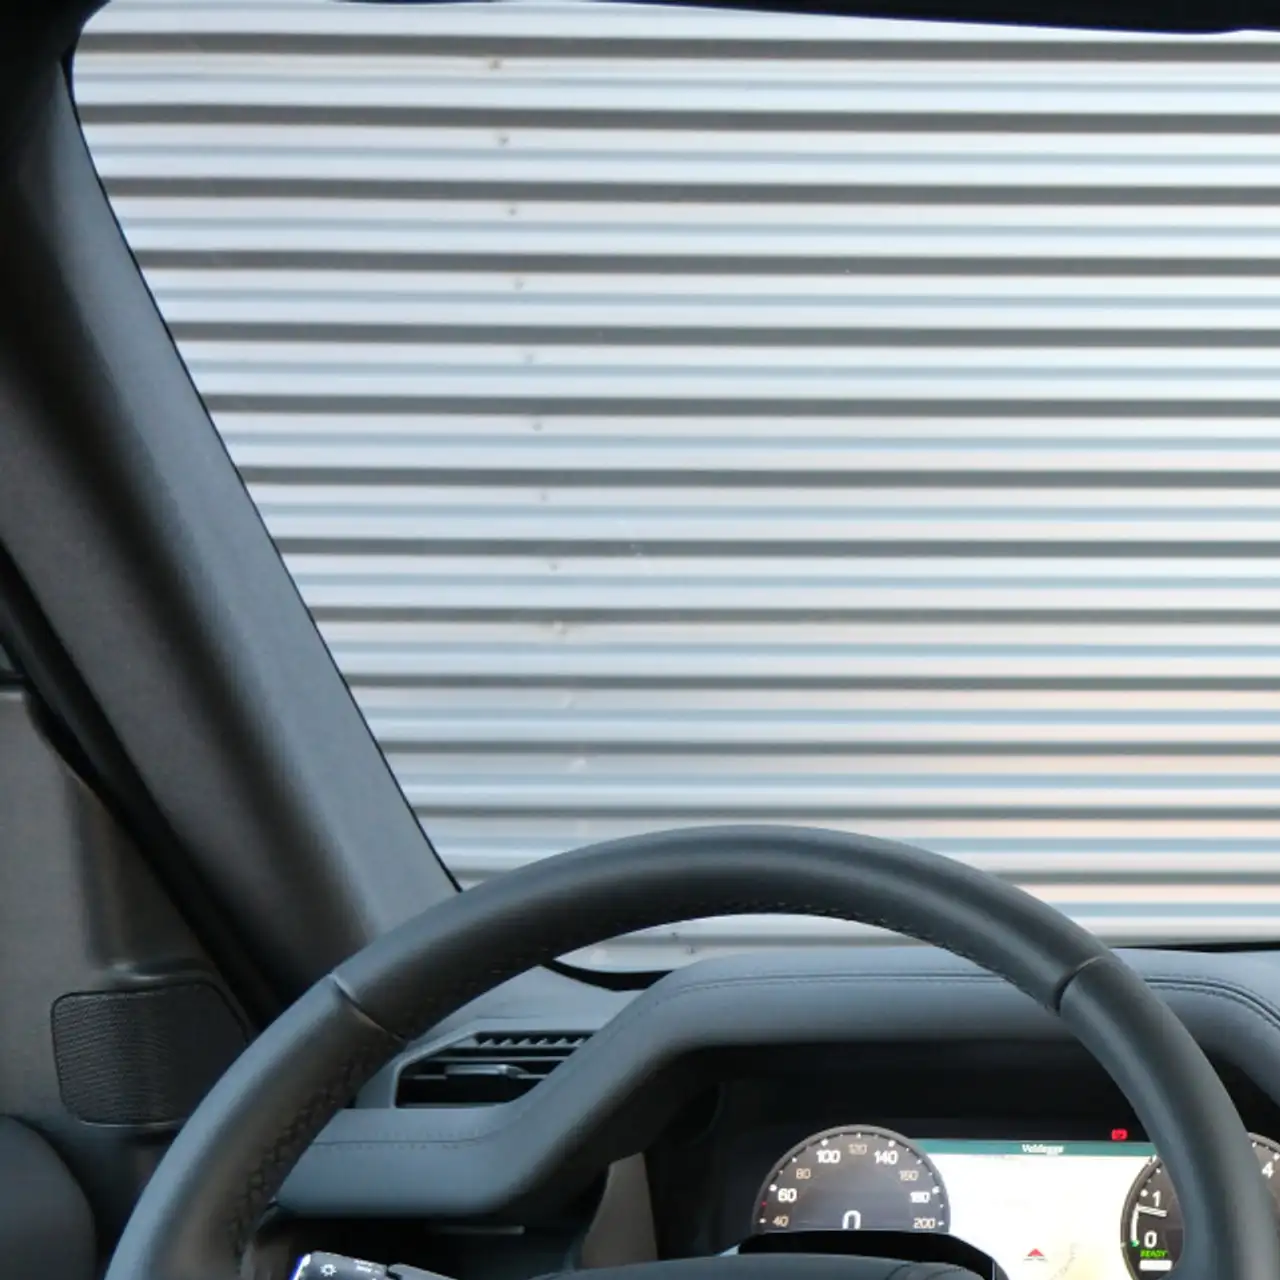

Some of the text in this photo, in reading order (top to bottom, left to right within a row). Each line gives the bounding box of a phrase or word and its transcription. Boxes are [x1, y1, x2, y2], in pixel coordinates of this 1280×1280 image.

[816, 1150, 841, 1163] 100
[874, 1150, 898, 1164] 140
[1261, 1162, 1274, 1178] 4
[778, 1188, 797, 1202] 60
[1152, 1190, 1161, 1207] 1
[773, 1215, 788, 1226] 40
[914, 1217, 936, 1229] 200
[1144, 1230, 1157, 1248] 0
